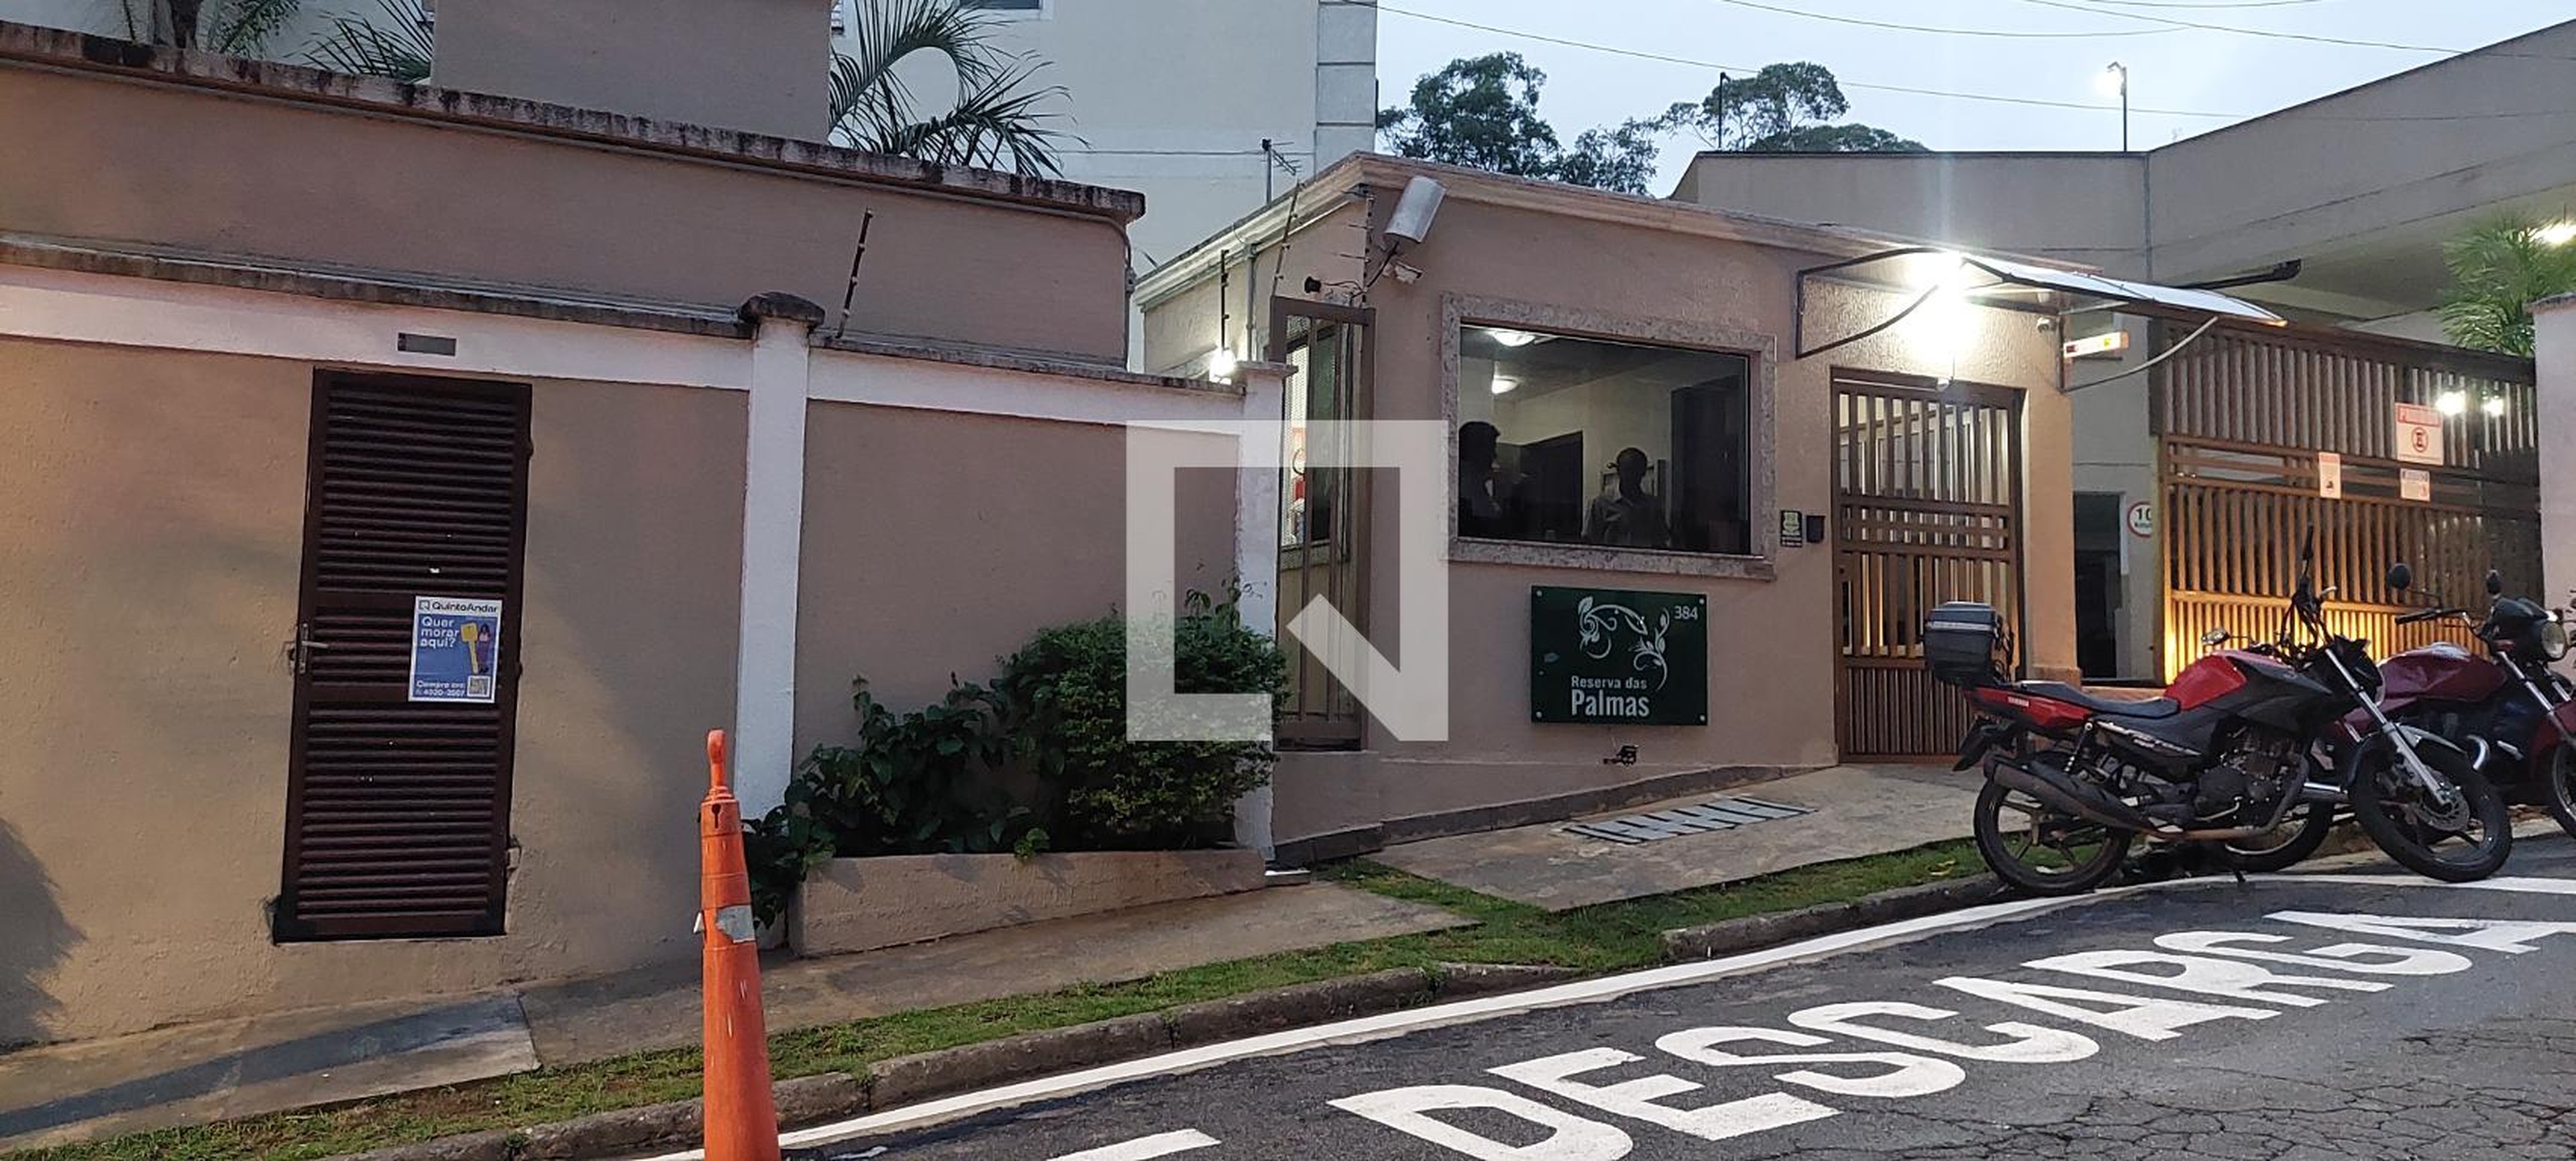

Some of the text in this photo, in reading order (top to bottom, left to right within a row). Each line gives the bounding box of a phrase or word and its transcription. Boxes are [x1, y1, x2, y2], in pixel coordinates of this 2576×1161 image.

[432, 601, 498, 613] QuintoAndar
[1674, 605, 1699, 620] 384
[421, 616, 455, 627] Quer
[421, 628, 460, 637] morar
[420, 637, 456, 649] aqui?
[1571, 675, 1648, 689] Reserva das
[1571, 689, 1650, 717] Palmas
[1326, 911, 2576, 1161] DESCARGA
